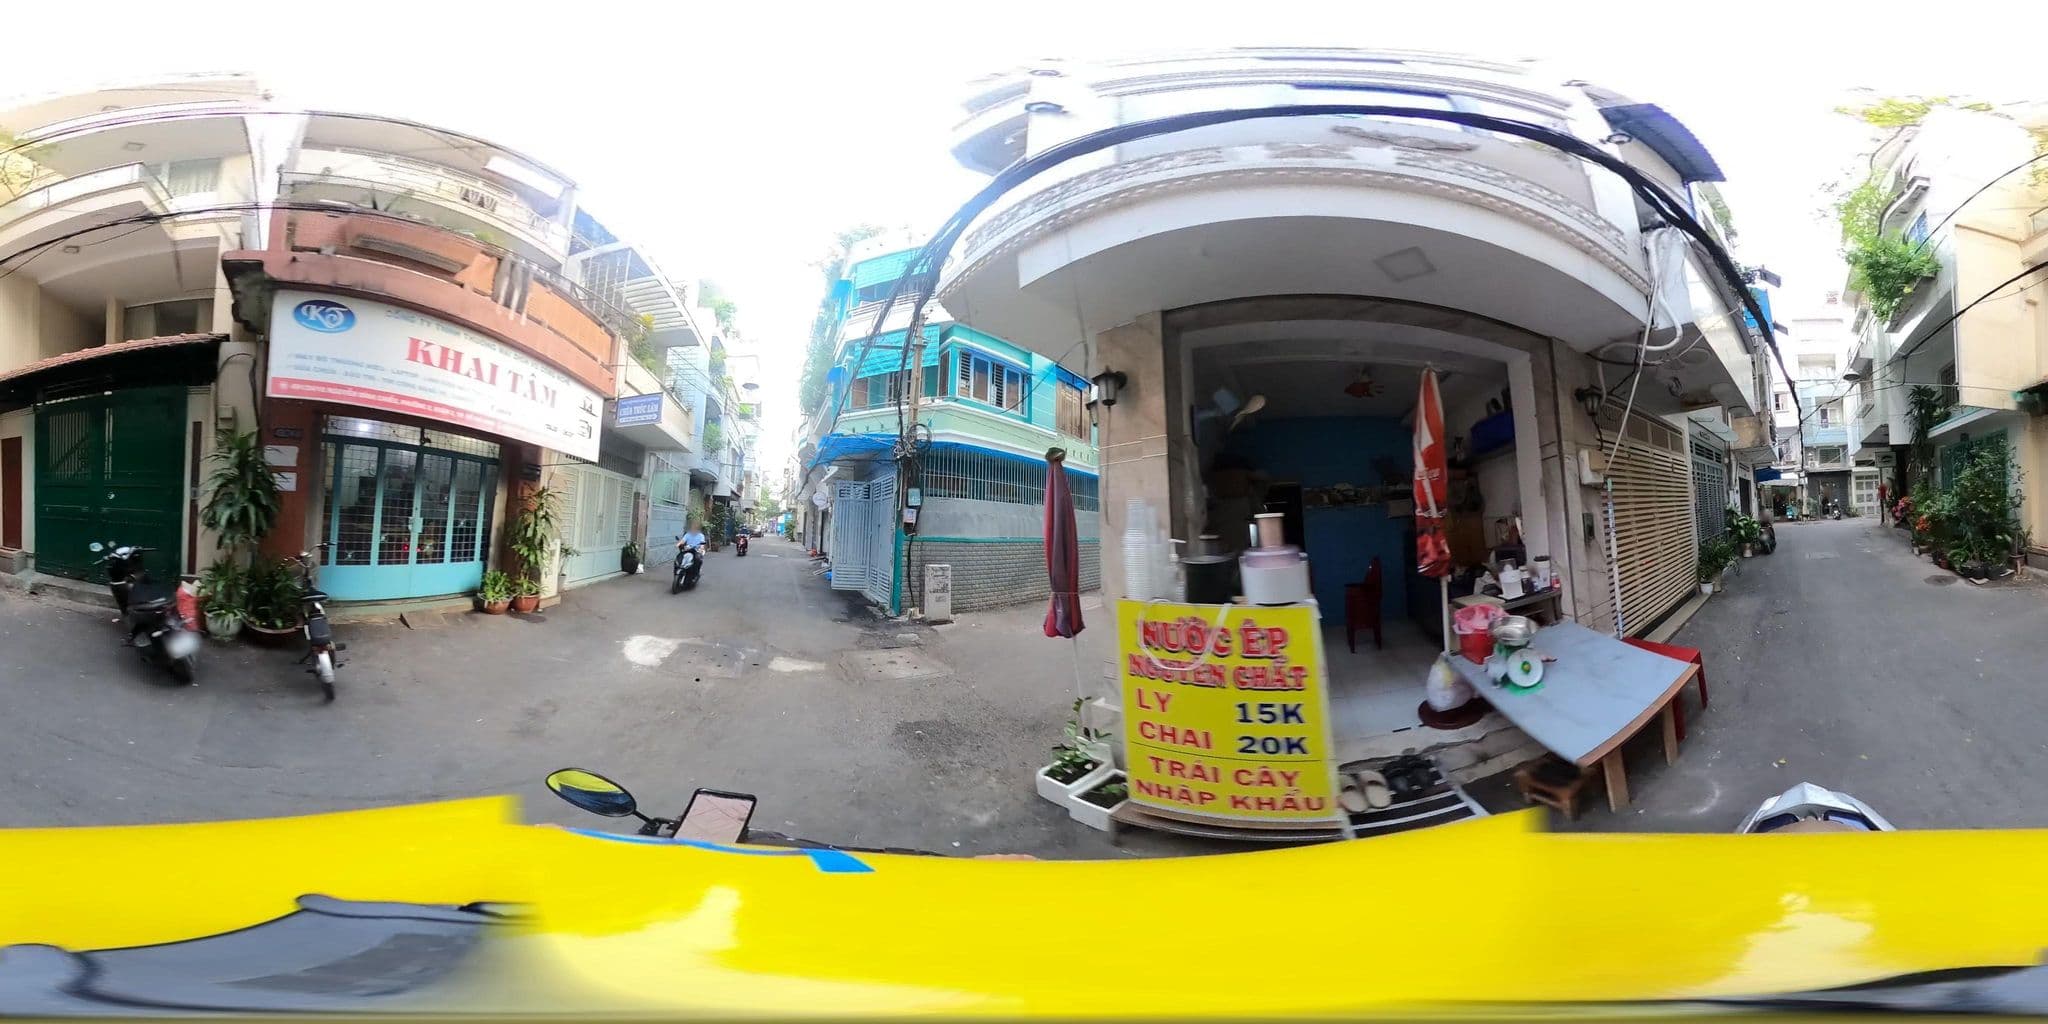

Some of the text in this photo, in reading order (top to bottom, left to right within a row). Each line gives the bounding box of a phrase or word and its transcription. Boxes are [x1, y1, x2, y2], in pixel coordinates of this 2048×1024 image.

[405, 336, 499, 386] KHAI
[508, 369, 557, 409] TÂM
[1140, 616, 1233, 657] NƯỚC
[1233, 656, 1308, 691] CHẤT
[1136, 688, 1306, 725] LY 15K
[1138, 721, 1309, 755] CHAI 20K
[1233, 765, 1300, 787] CÂY
